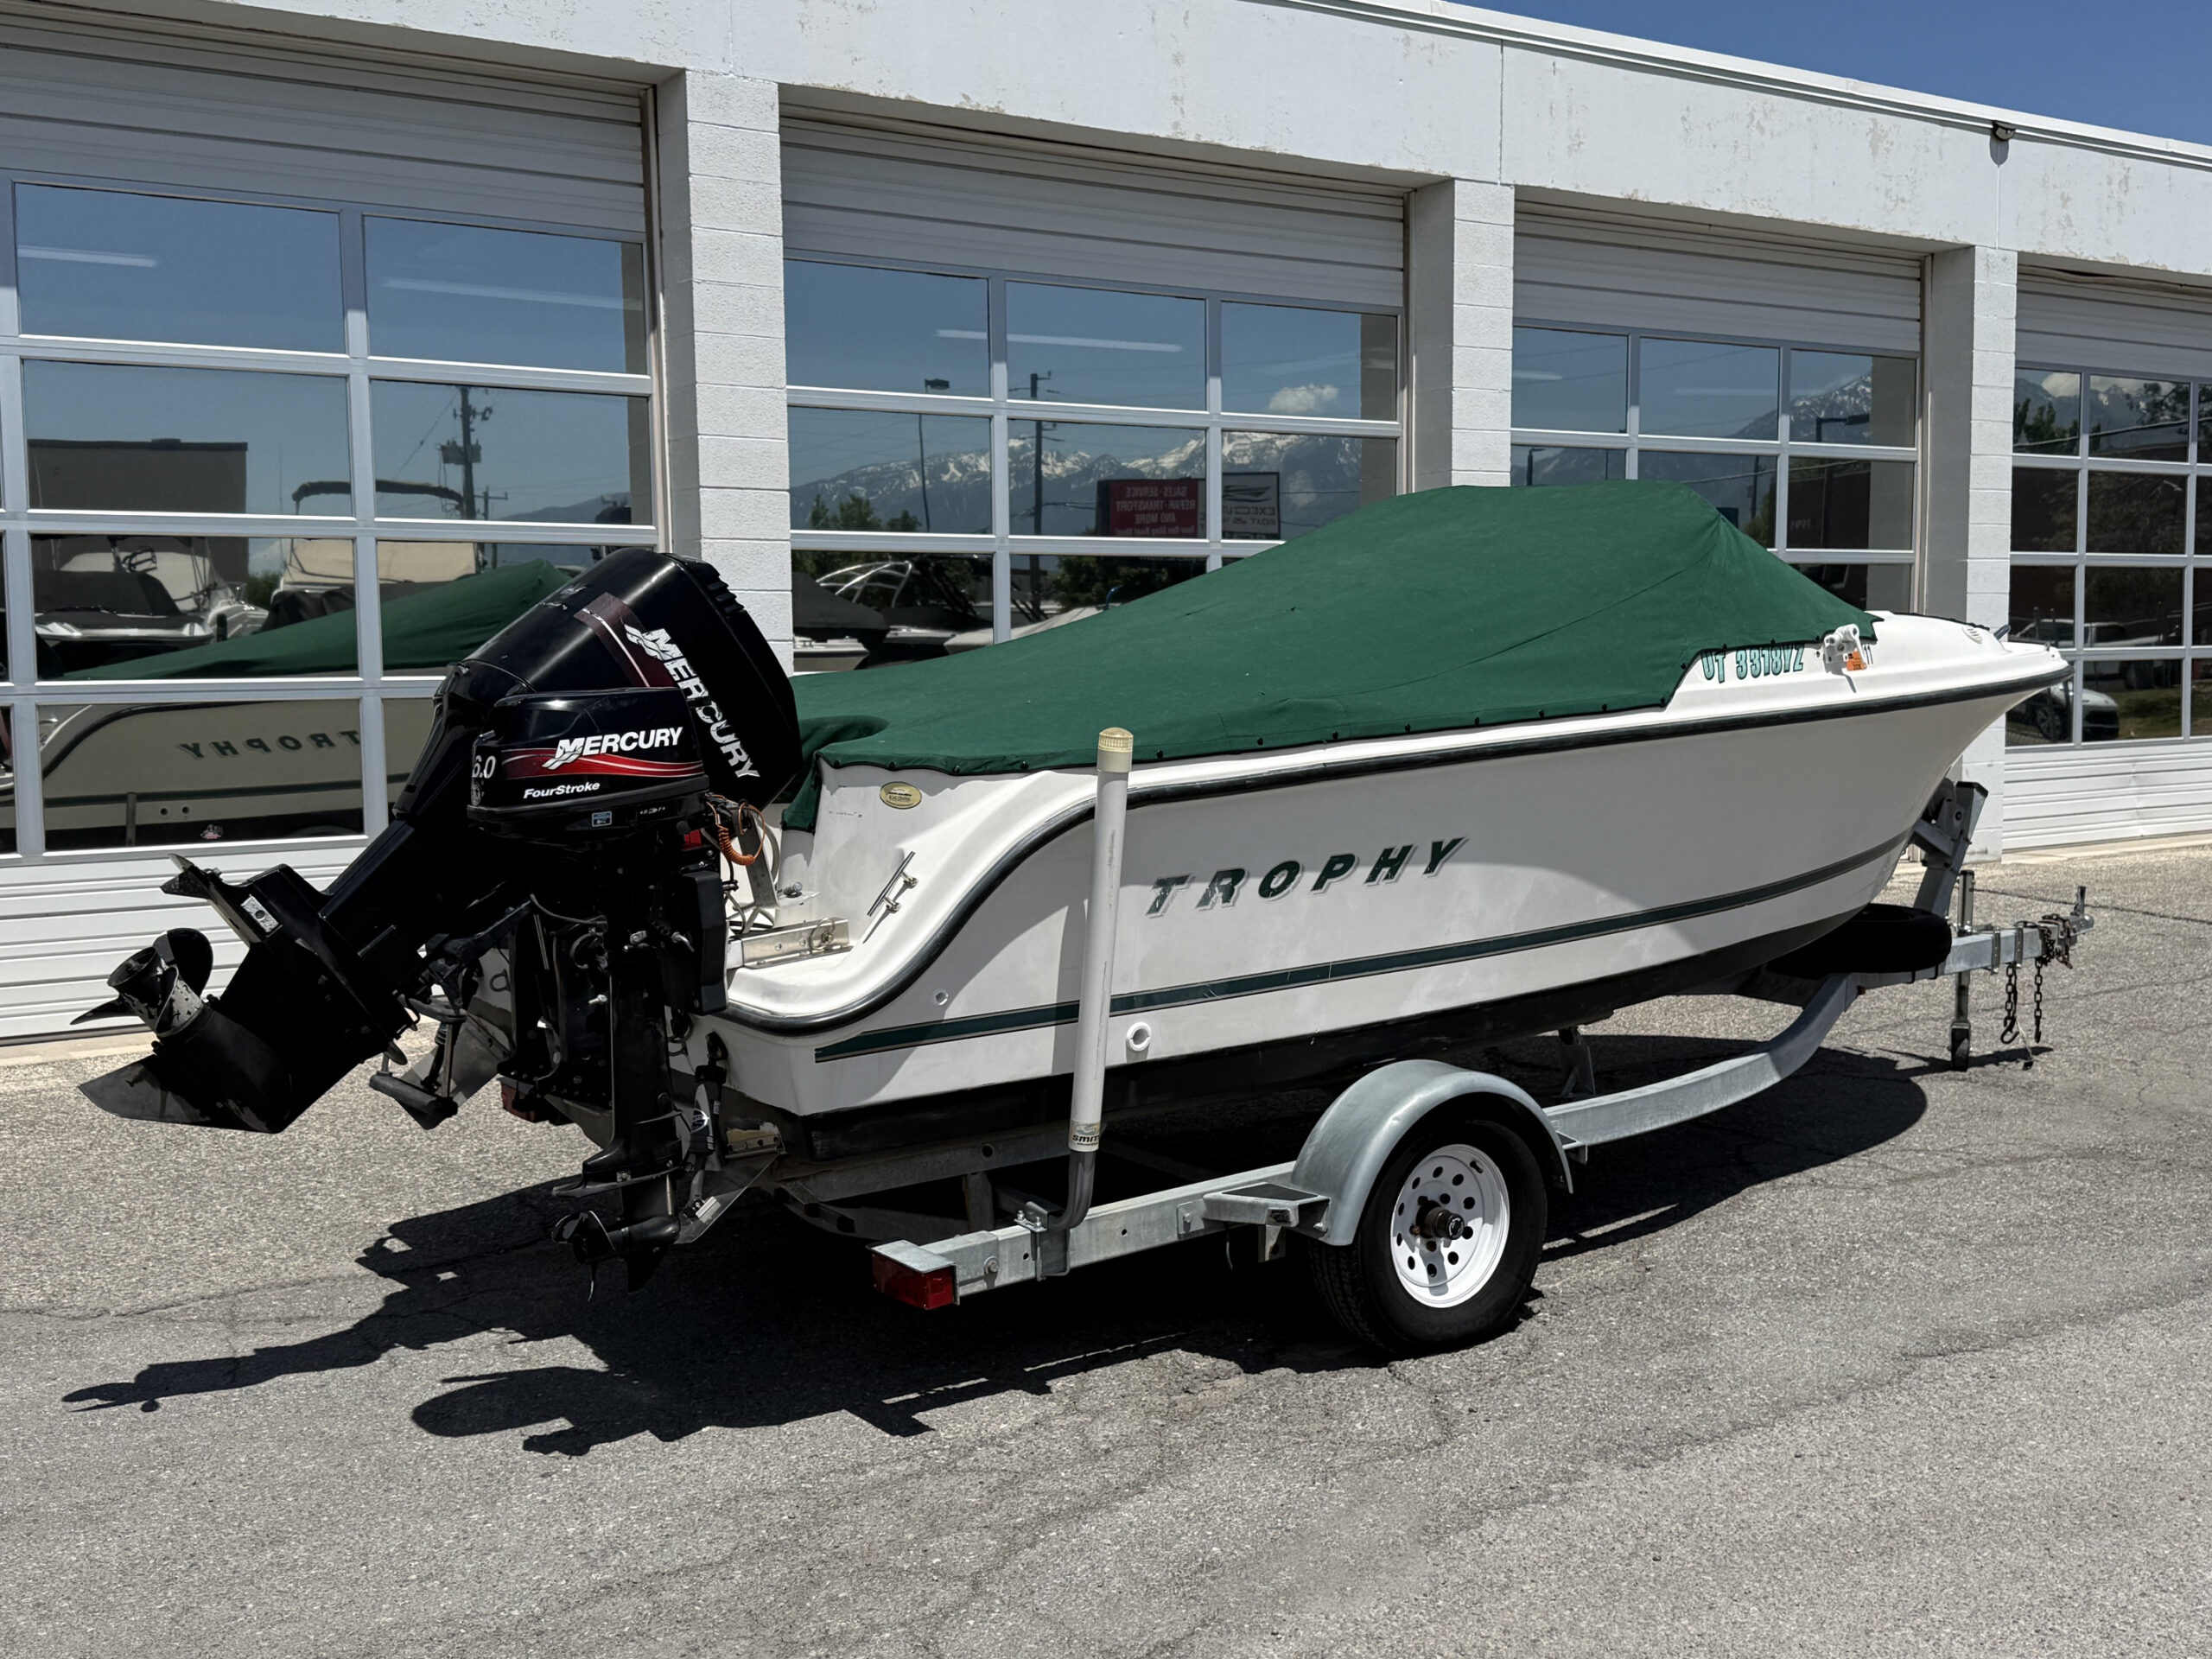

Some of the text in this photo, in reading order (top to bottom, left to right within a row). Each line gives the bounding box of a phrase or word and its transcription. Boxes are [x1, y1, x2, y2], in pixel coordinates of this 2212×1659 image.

[1700, 645, 1806, 684] UT 3318YZ
[641, 627, 760, 779] MERCURY
[555, 727, 683, 759] MERCURY
[523, 781, 601, 799] FourStroke
[1145, 836, 1470, 918] TROPHY
